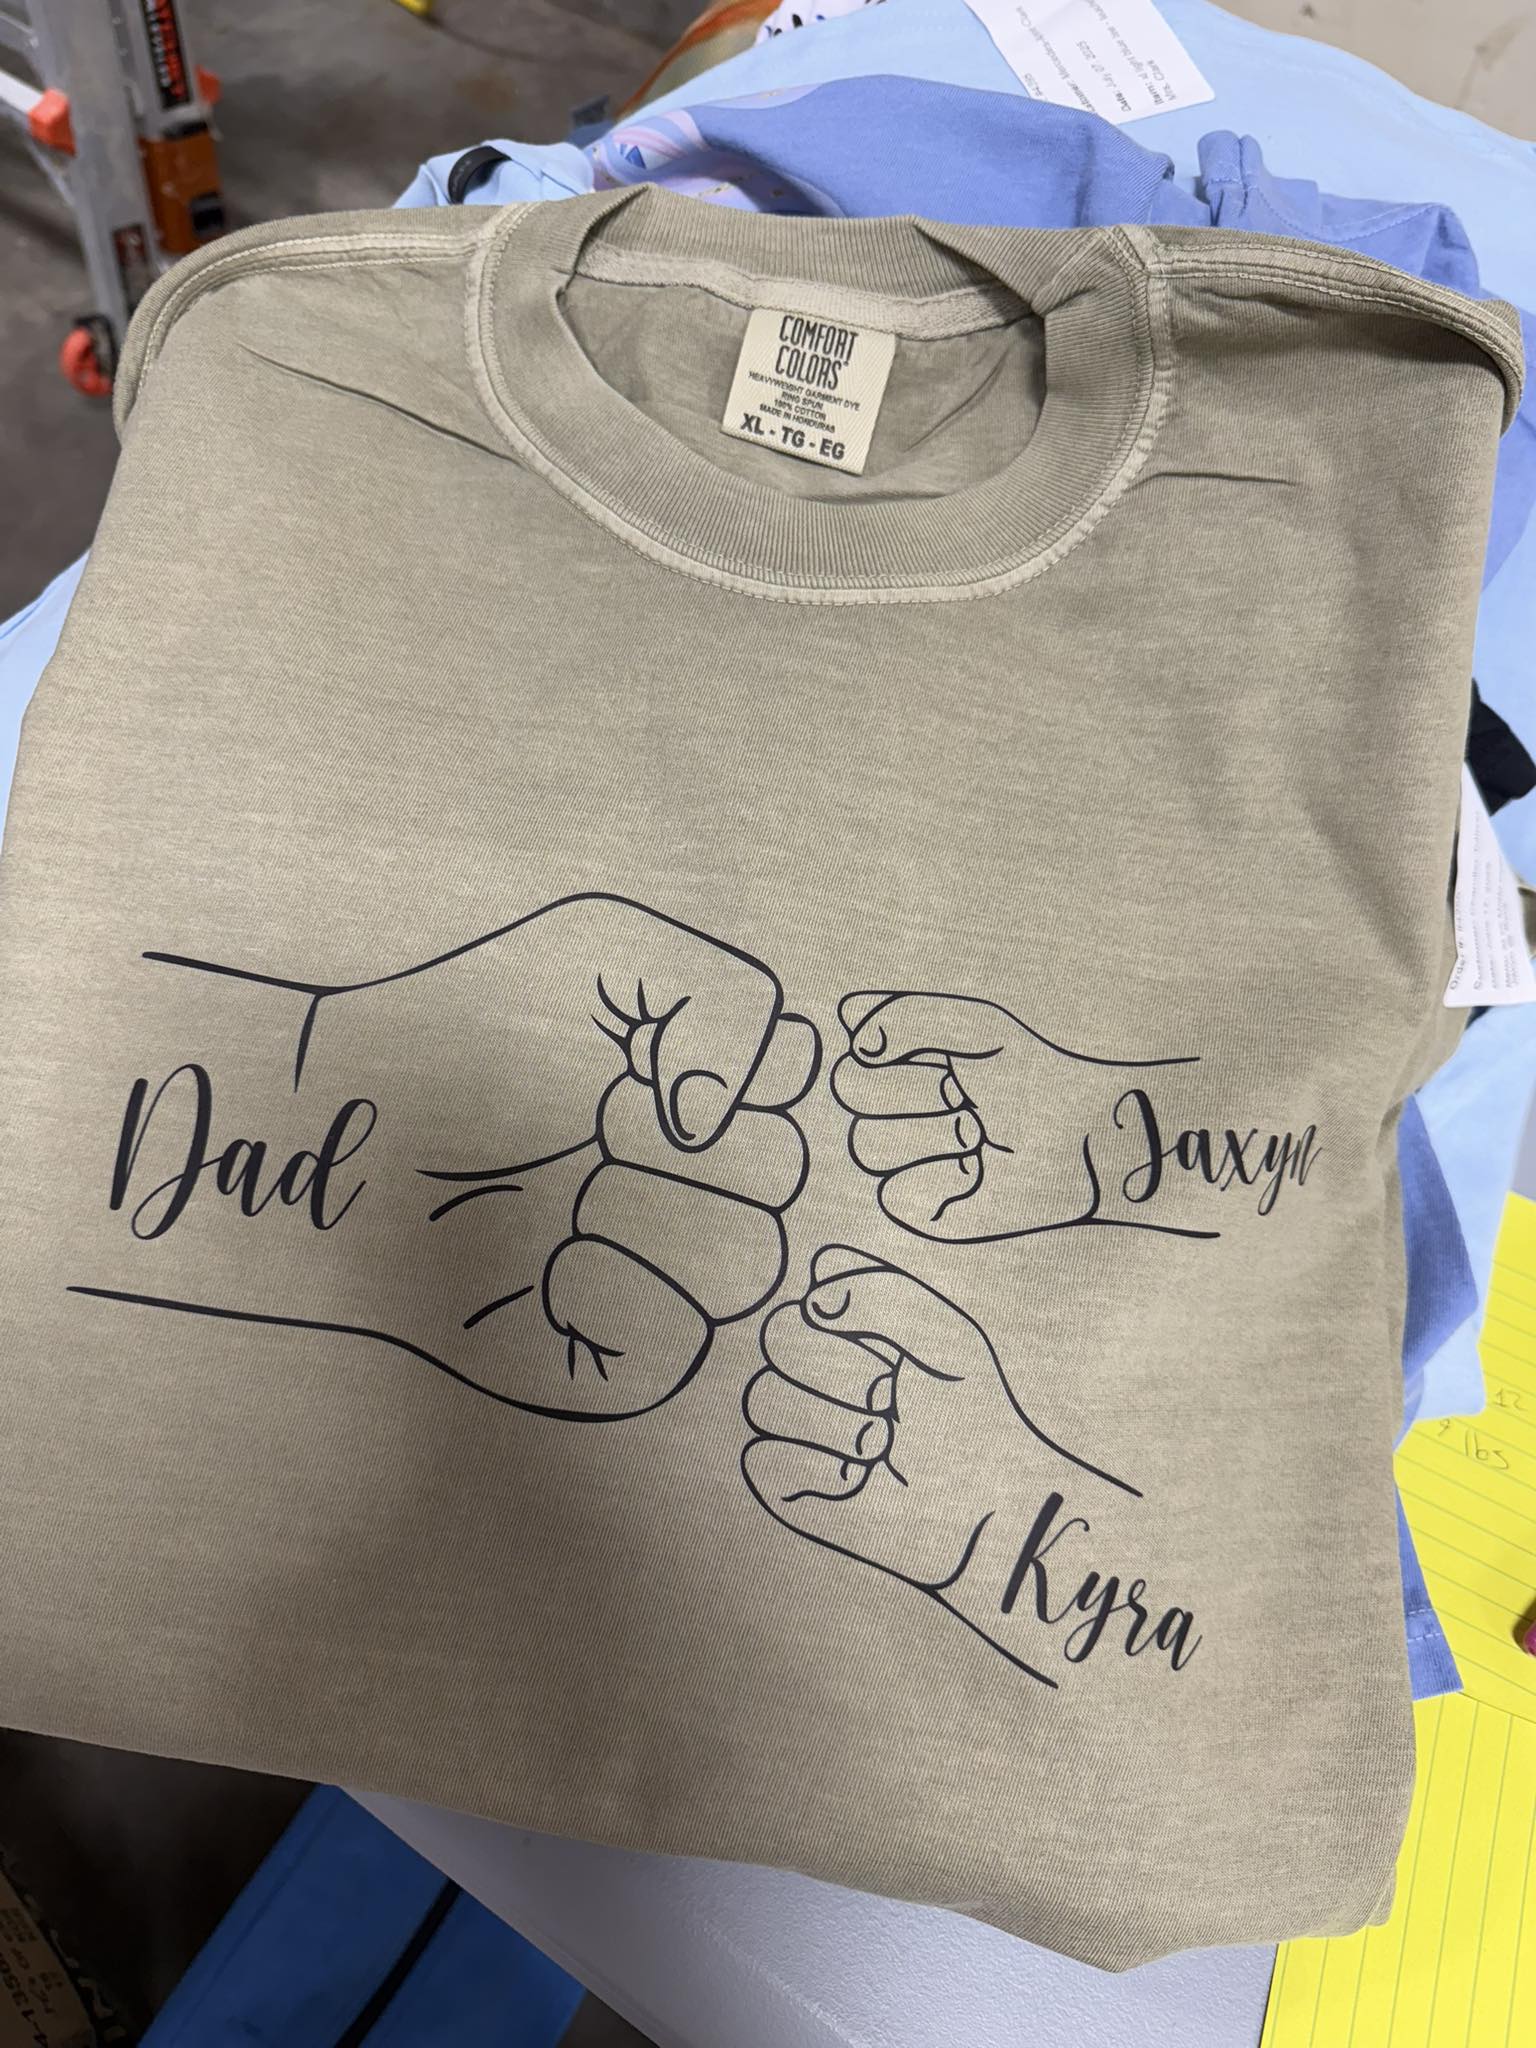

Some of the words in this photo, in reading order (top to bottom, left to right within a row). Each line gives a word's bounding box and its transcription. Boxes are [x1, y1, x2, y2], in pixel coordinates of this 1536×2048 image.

[1147, 59, 1165, 82] Clark
[1114, 91, 1132, 113] Date:
[779, 315, 859, 363] COMFORT
[775, 345, 843, 391] COLORS
[748, 371, 804, 396] HEAVYWEIGHT
[805, 388, 844, 408] GARMENT
[843, 398, 861, 411] DYE
[781, 391, 801, 405] RING
[802, 397, 824, 411] SPUN
[759, 403, 782, 417] MADE
[783, 411, 792, 420] IN
[792, 413, 836, 433] HONDURAS
[774, 399, 793, 412] 100%
[794, 405, 827, 421] COTTON
[740, 412, 765, 436] XL
[781, 425, 806, 448] TG
[819, 438, 845, 460] EG
[1450, 955, 1467, 990] Order
[109, 1063, 378, 1240] Dad
[1113, 1088, 1323, 1216] Jaxyn
[1493, 1388, 1529, 1412] 12
[1000, 1491, 1203, 1671] Kyra
